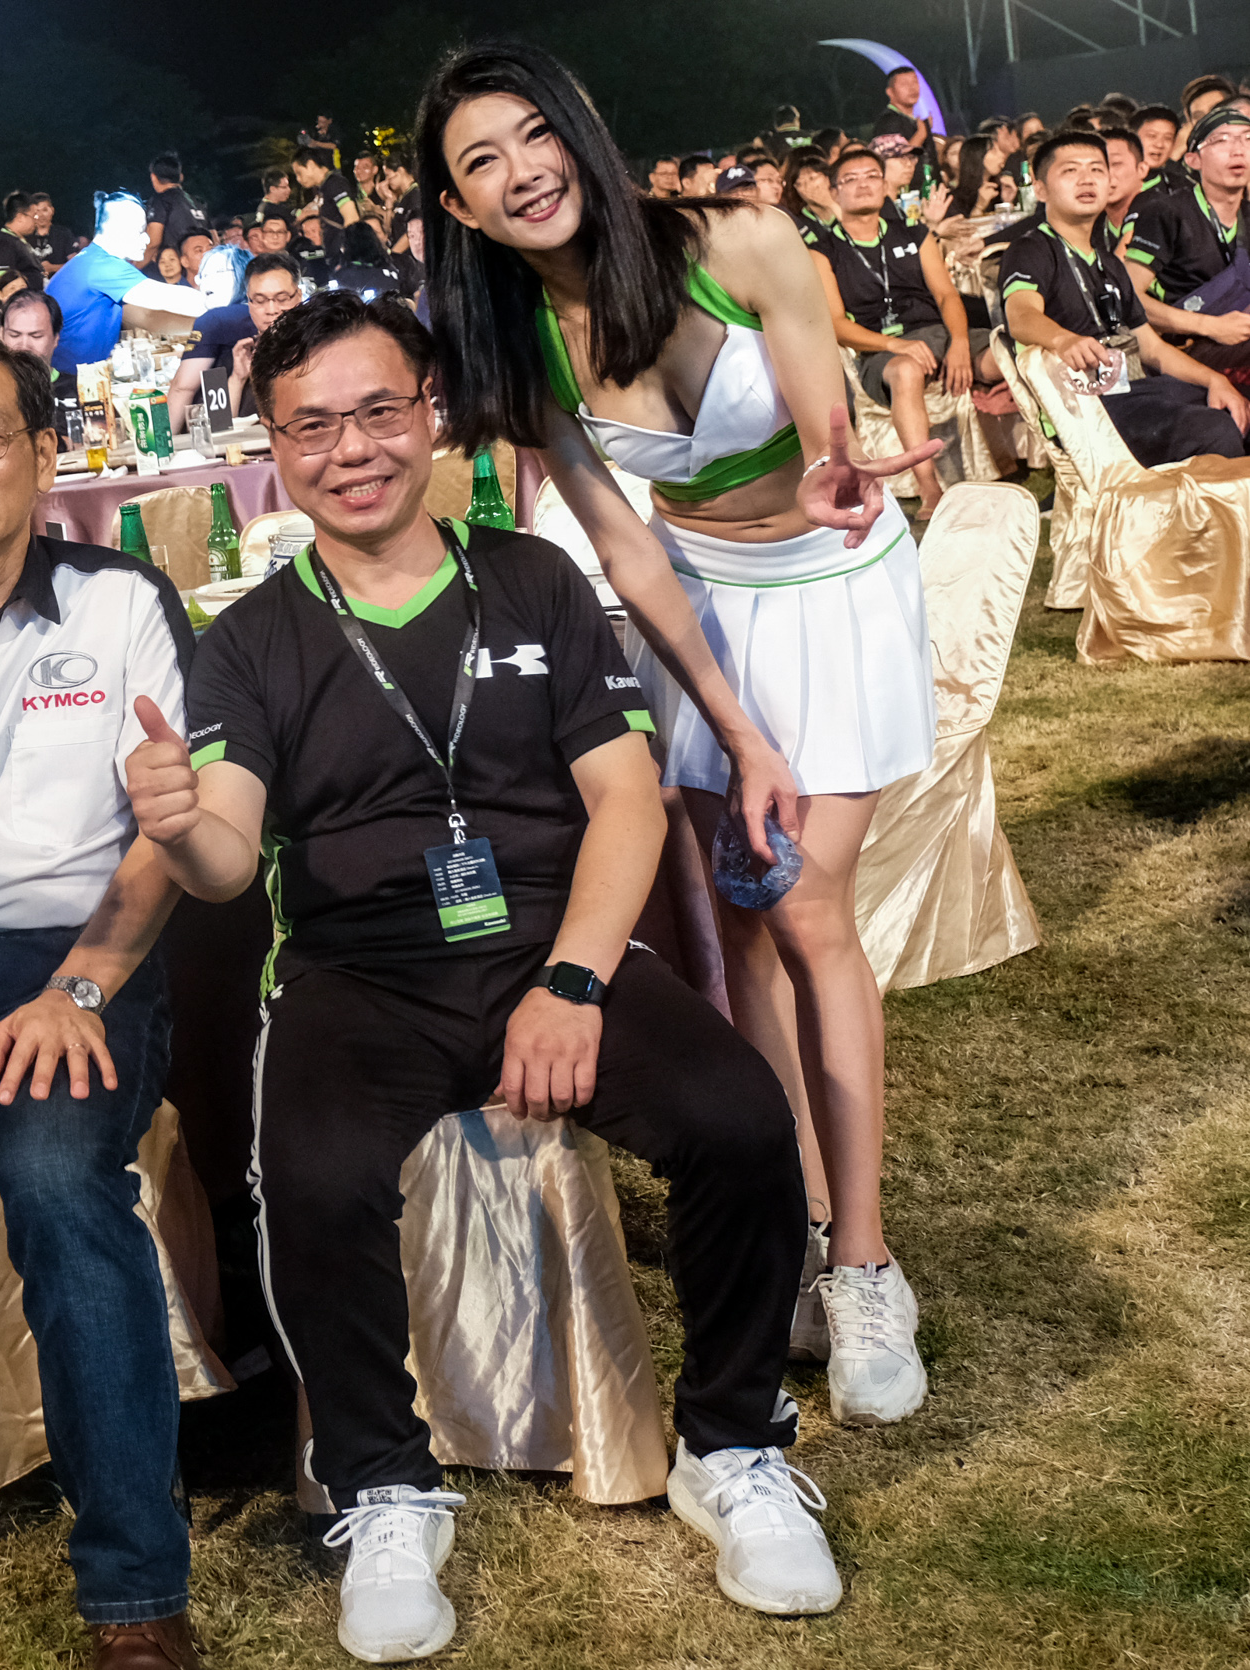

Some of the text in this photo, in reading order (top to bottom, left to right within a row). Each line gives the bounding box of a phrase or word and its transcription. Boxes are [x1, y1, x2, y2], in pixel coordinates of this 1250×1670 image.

[207, 387, 228, 411] 20
[356, 637, 395, 690] RIDEOLOGY
[22, 690, 106, 711] KYMCO
